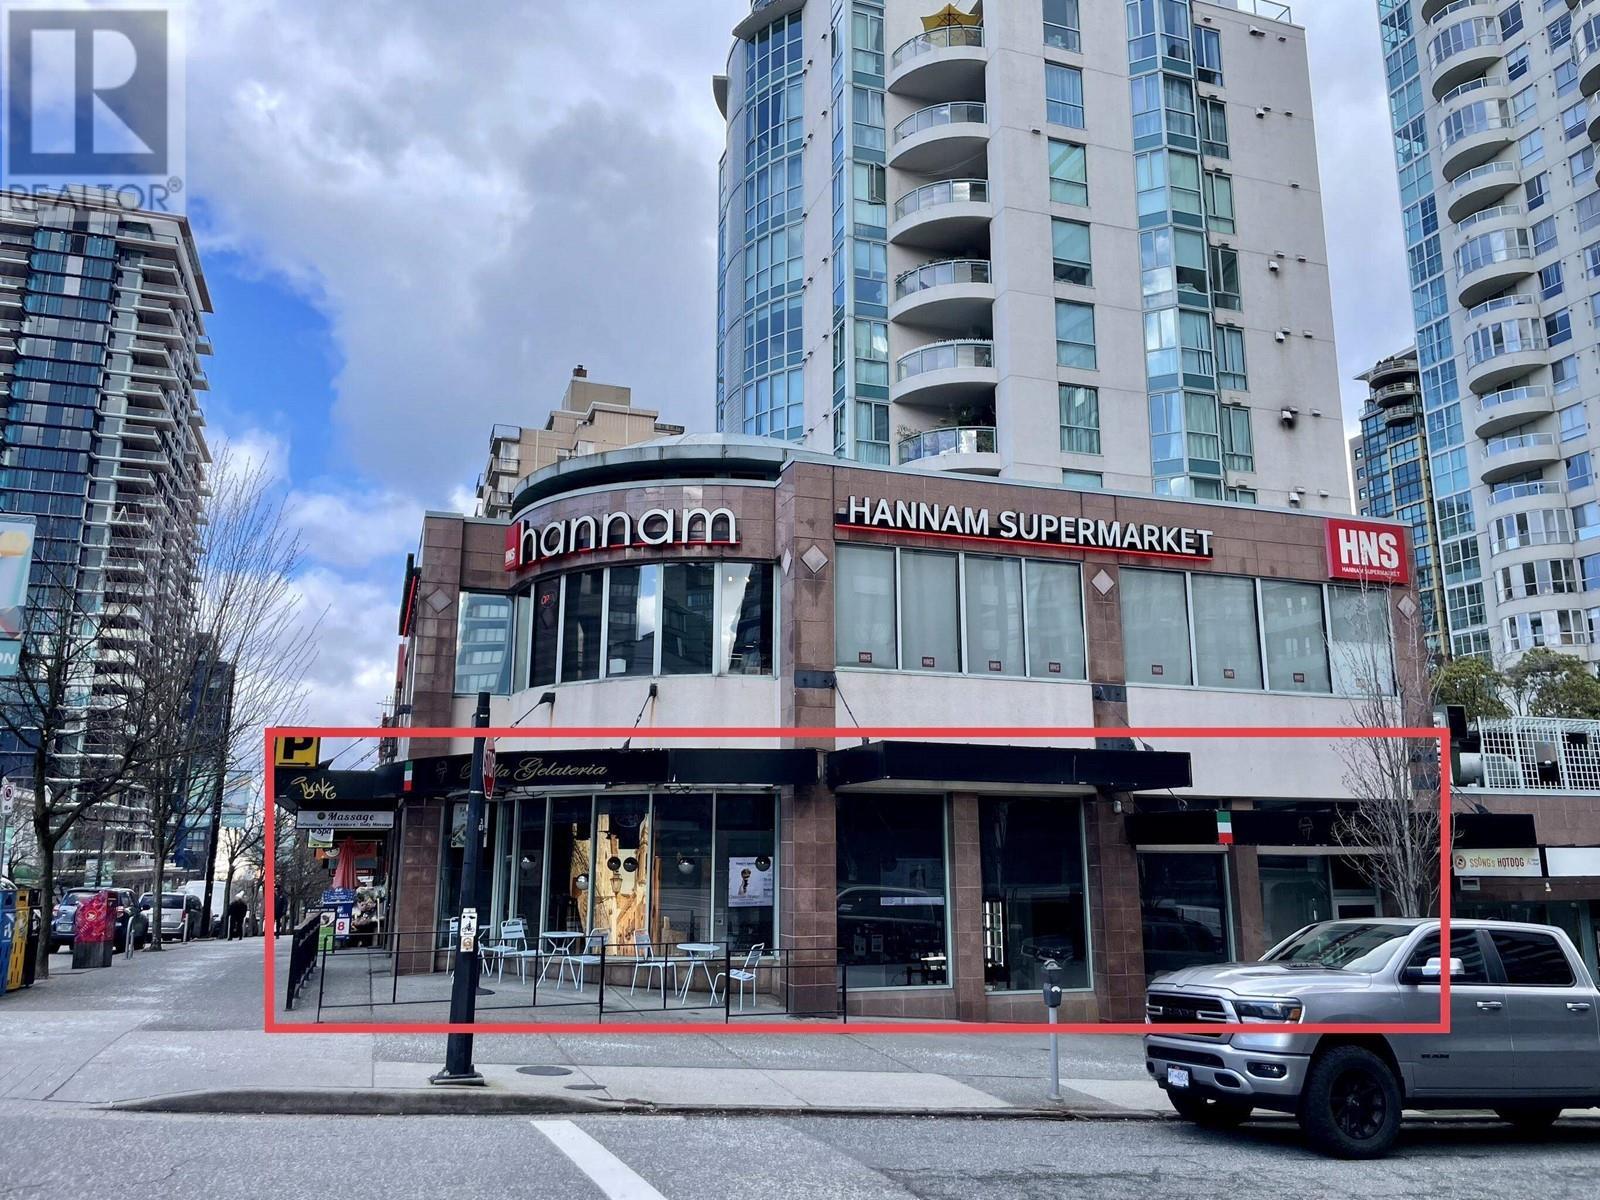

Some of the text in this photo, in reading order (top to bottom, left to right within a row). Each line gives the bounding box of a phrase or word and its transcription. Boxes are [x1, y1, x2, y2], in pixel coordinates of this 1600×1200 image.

[519, 507, 737, 564] hannam
[849, 495, 1213, 555] HANNAM SUPERMARKET
[1338, 528, 1399, 569] HNS
[283, 736, 313, 759] P
[514, 757, 607, 781] Gelateria
[327, 812, 375, 823] Massage
[337, 921, 345, 931] 8
